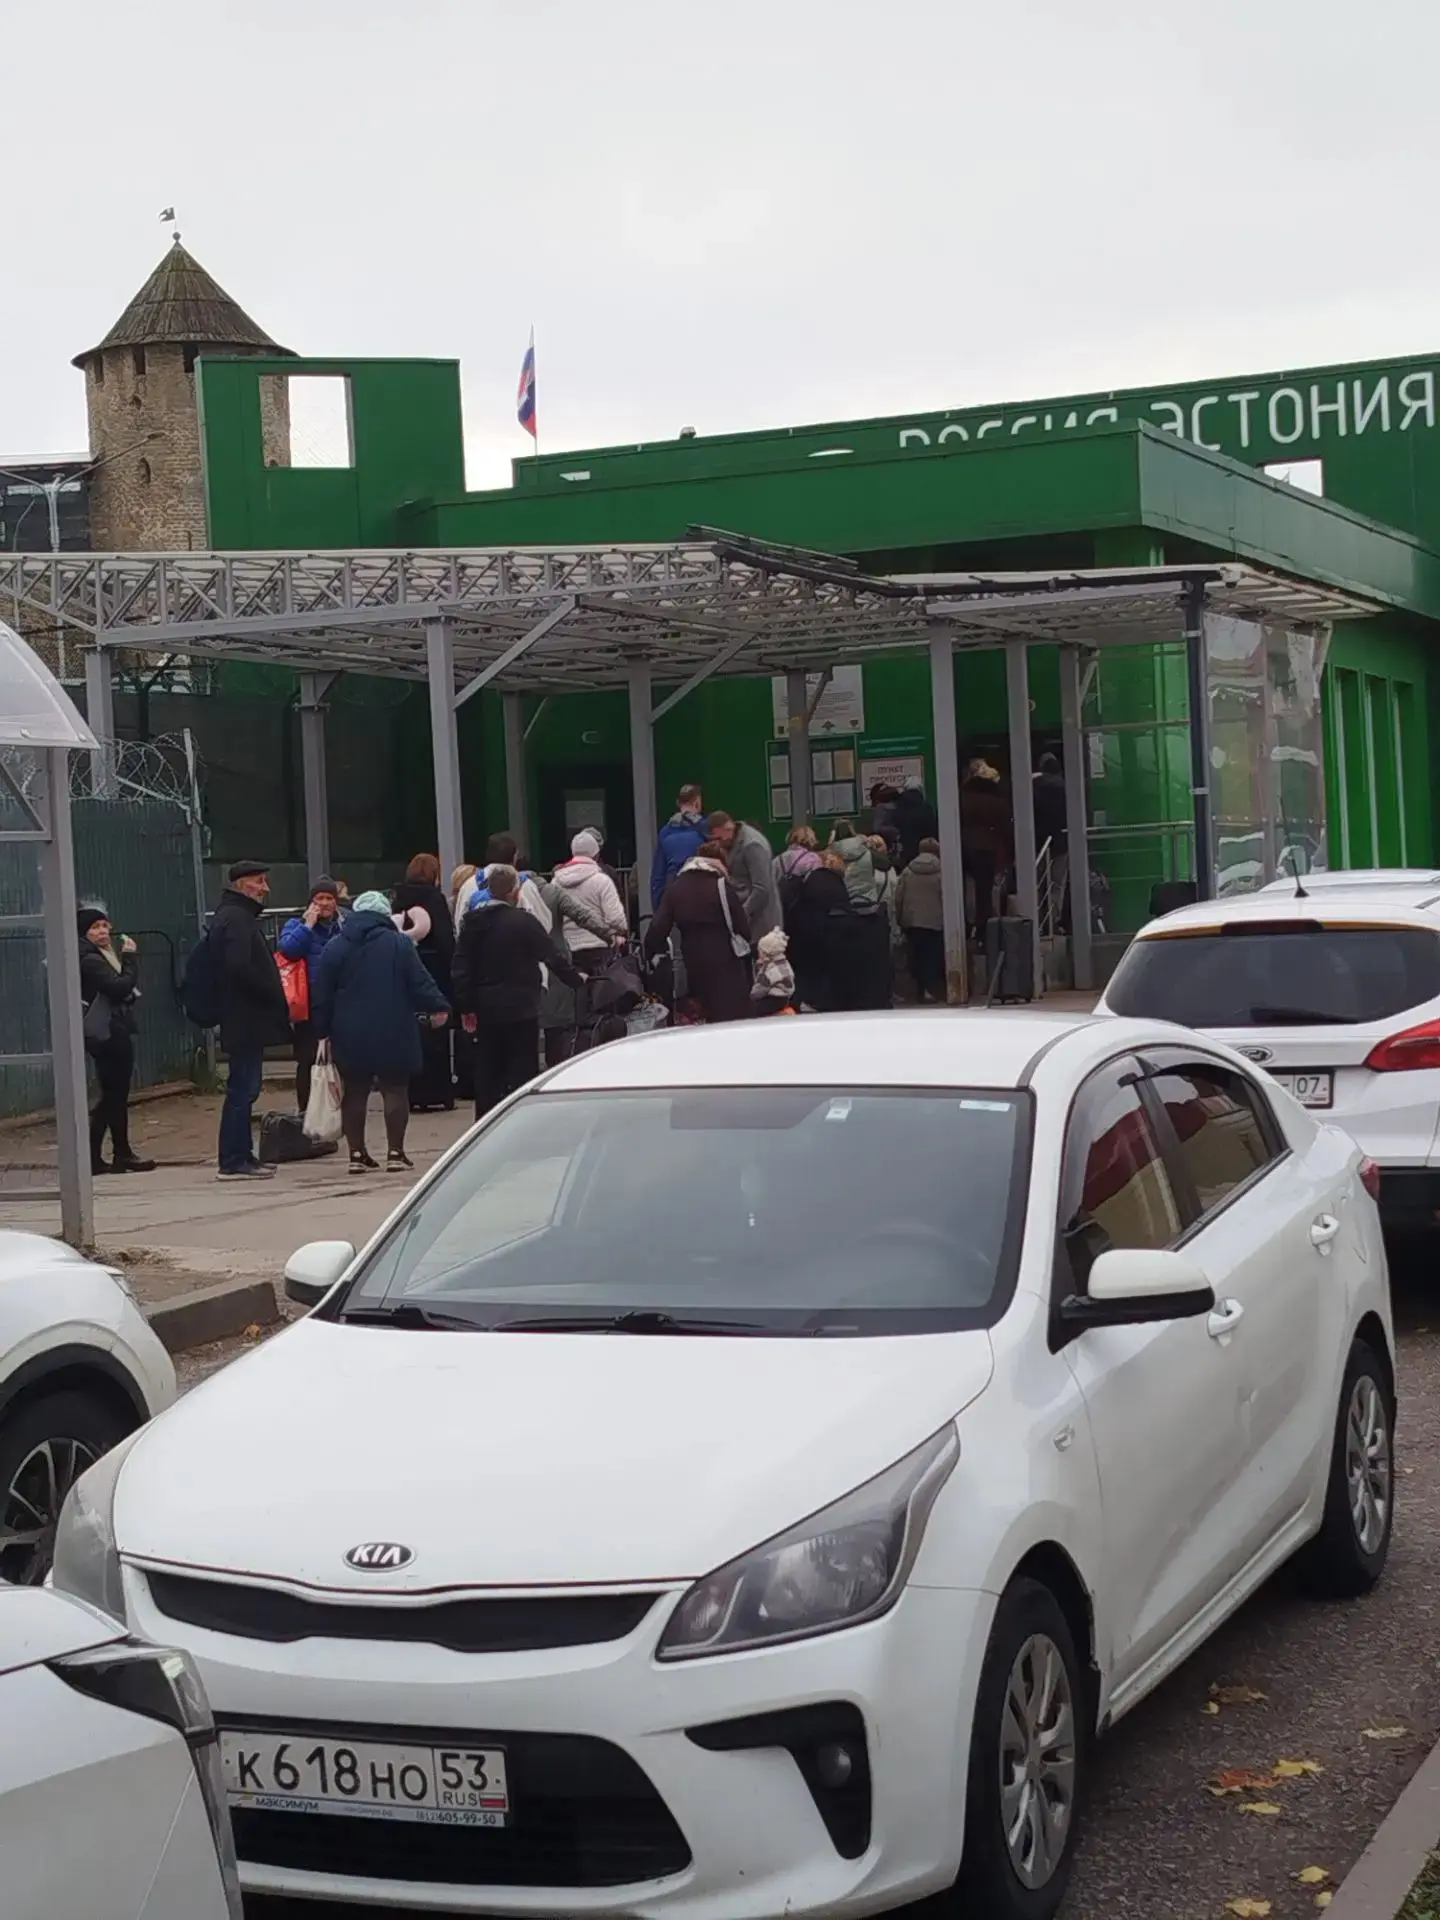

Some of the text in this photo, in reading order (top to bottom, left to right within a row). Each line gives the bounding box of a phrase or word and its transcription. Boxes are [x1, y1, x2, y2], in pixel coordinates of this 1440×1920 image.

[1149, 371, 1435, 453] ЭСТОНИЯ
[1296, 1076, 1320, 1095] 07
[352, 1544, 401, 1565] KIA
[440, 1752, 489, 1791] 53
[442, 1791, 478, 1807] RUS
